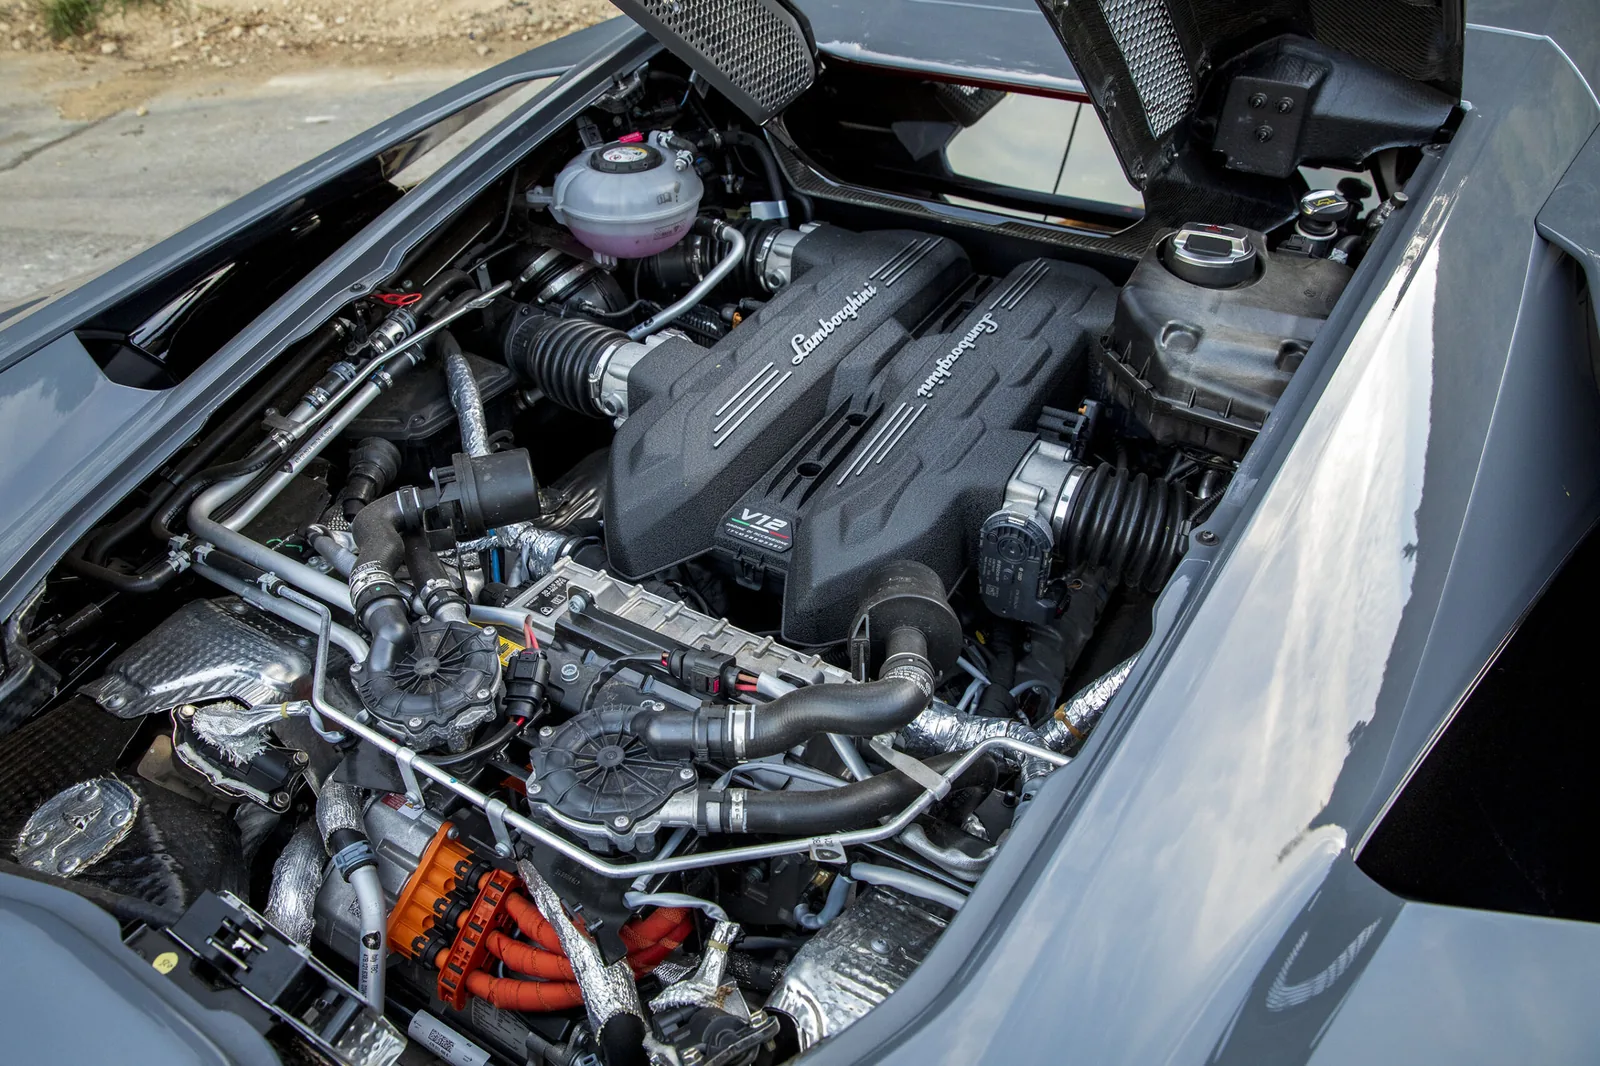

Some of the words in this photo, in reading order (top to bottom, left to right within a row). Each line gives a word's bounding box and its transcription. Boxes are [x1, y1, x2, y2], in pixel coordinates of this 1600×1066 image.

[791, 282, 877, 365] Lamborghini
[917, 312, 999, 398] Lamborghini
[741, 508, 788, 531] V12
[754, 532, 789, 546] ACCENSIONE
